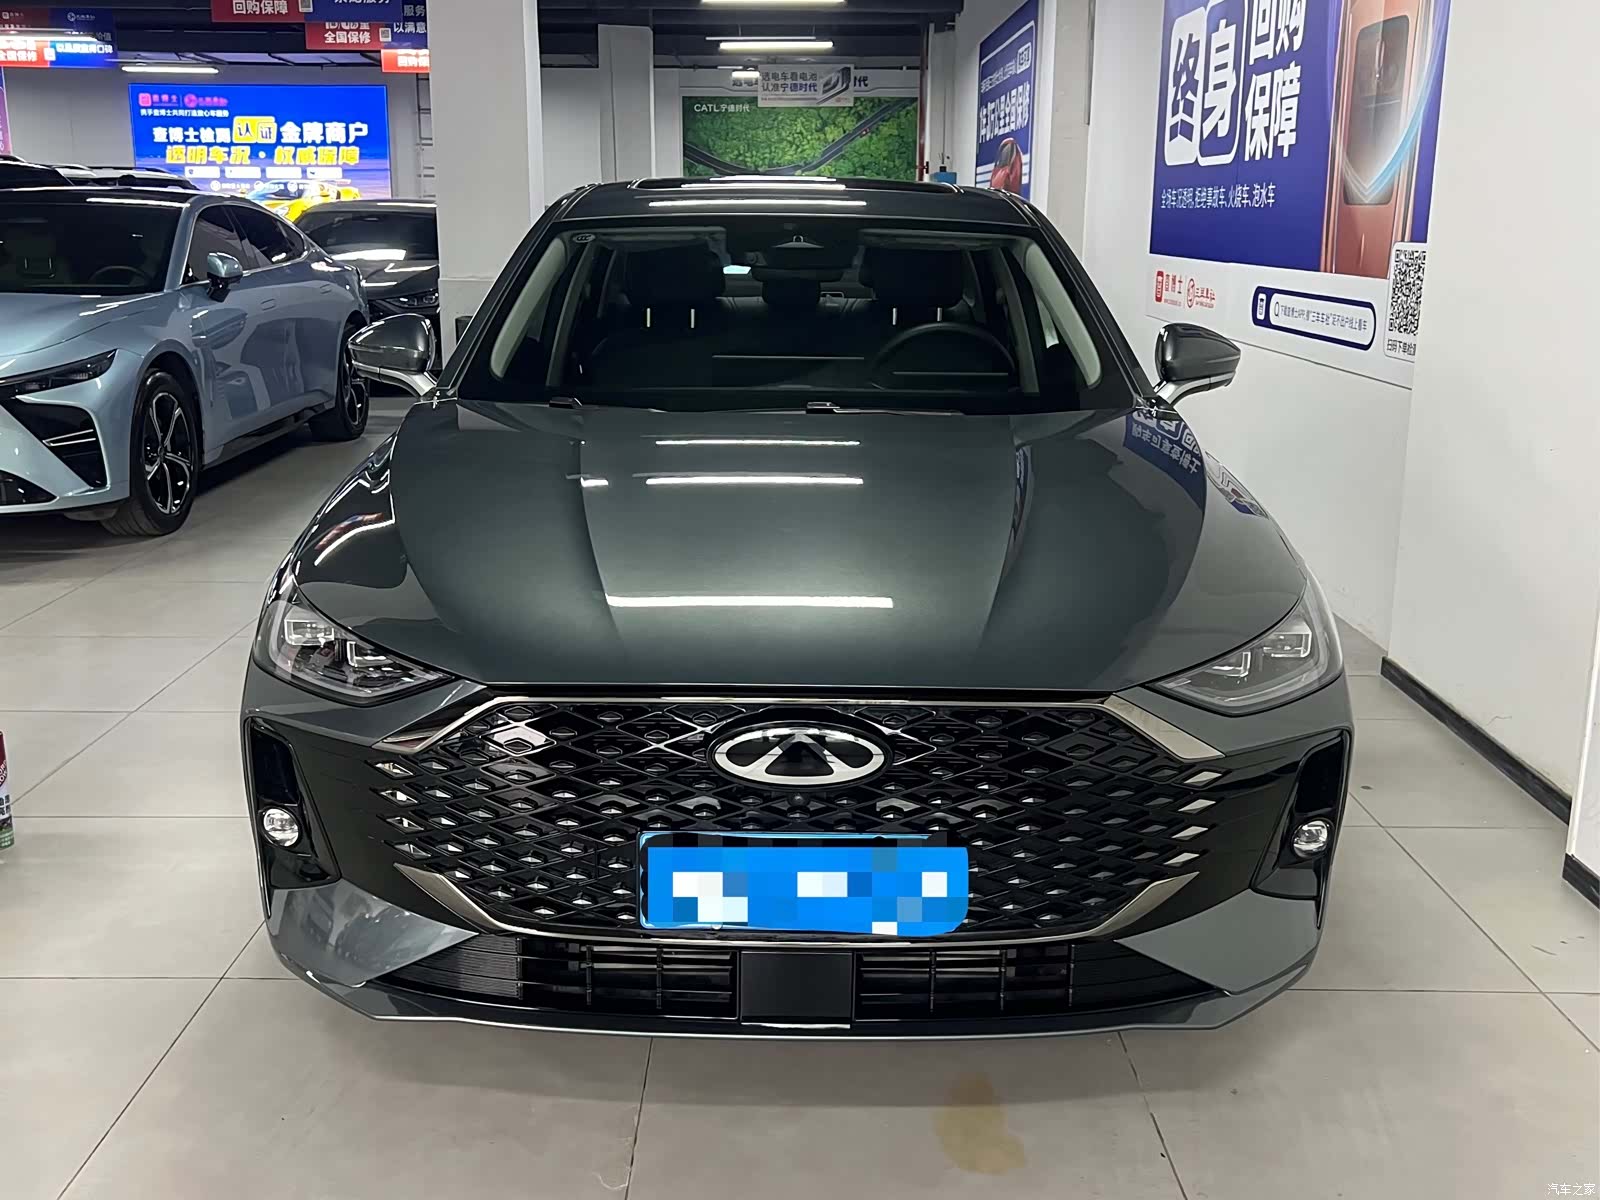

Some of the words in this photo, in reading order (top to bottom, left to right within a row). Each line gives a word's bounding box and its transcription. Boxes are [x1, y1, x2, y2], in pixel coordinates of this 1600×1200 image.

[233, 0, 288, 15] 回购保障
[324, 31, 371, 44] 全国保修
[1249, 0, 1307, 65] 回购
[761, 71, 818, 82] 选电车看电池
[1168, 18, 1237, 143] 终身
[761, 82, 818, 93] 认准宁德时代
[693, 103, 719, 113] CATL
[720, 103, 750, 113] 宁德时代
[1245, 60, 1301, 161] 保障
[237, 121, 275, 141] 认证
[280, 121, 369, 144] 金牌商户
